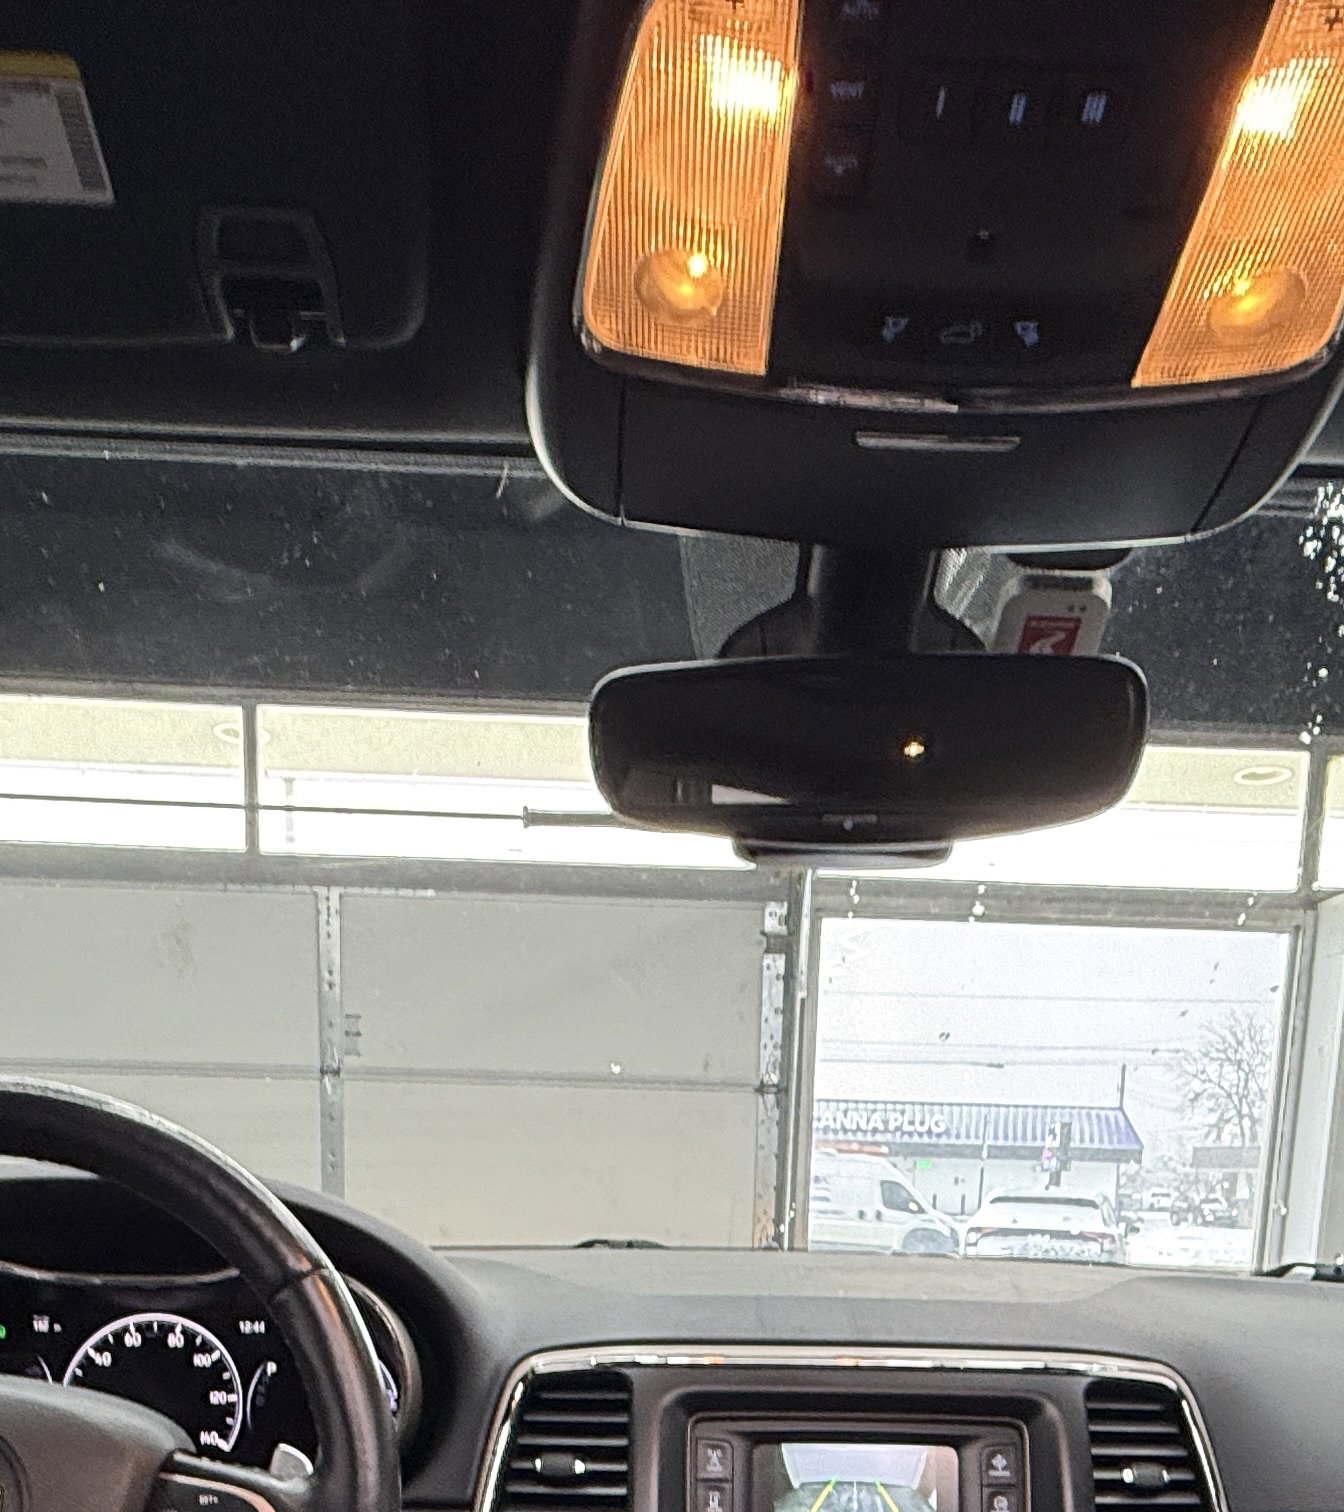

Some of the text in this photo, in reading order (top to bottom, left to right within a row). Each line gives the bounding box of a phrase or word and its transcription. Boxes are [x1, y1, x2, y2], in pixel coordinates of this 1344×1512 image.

[888, 1112, 946, 1133] PLUG
[193, 1353, 212, 1367] 100
[209, 1391, 227, 1405] 120
